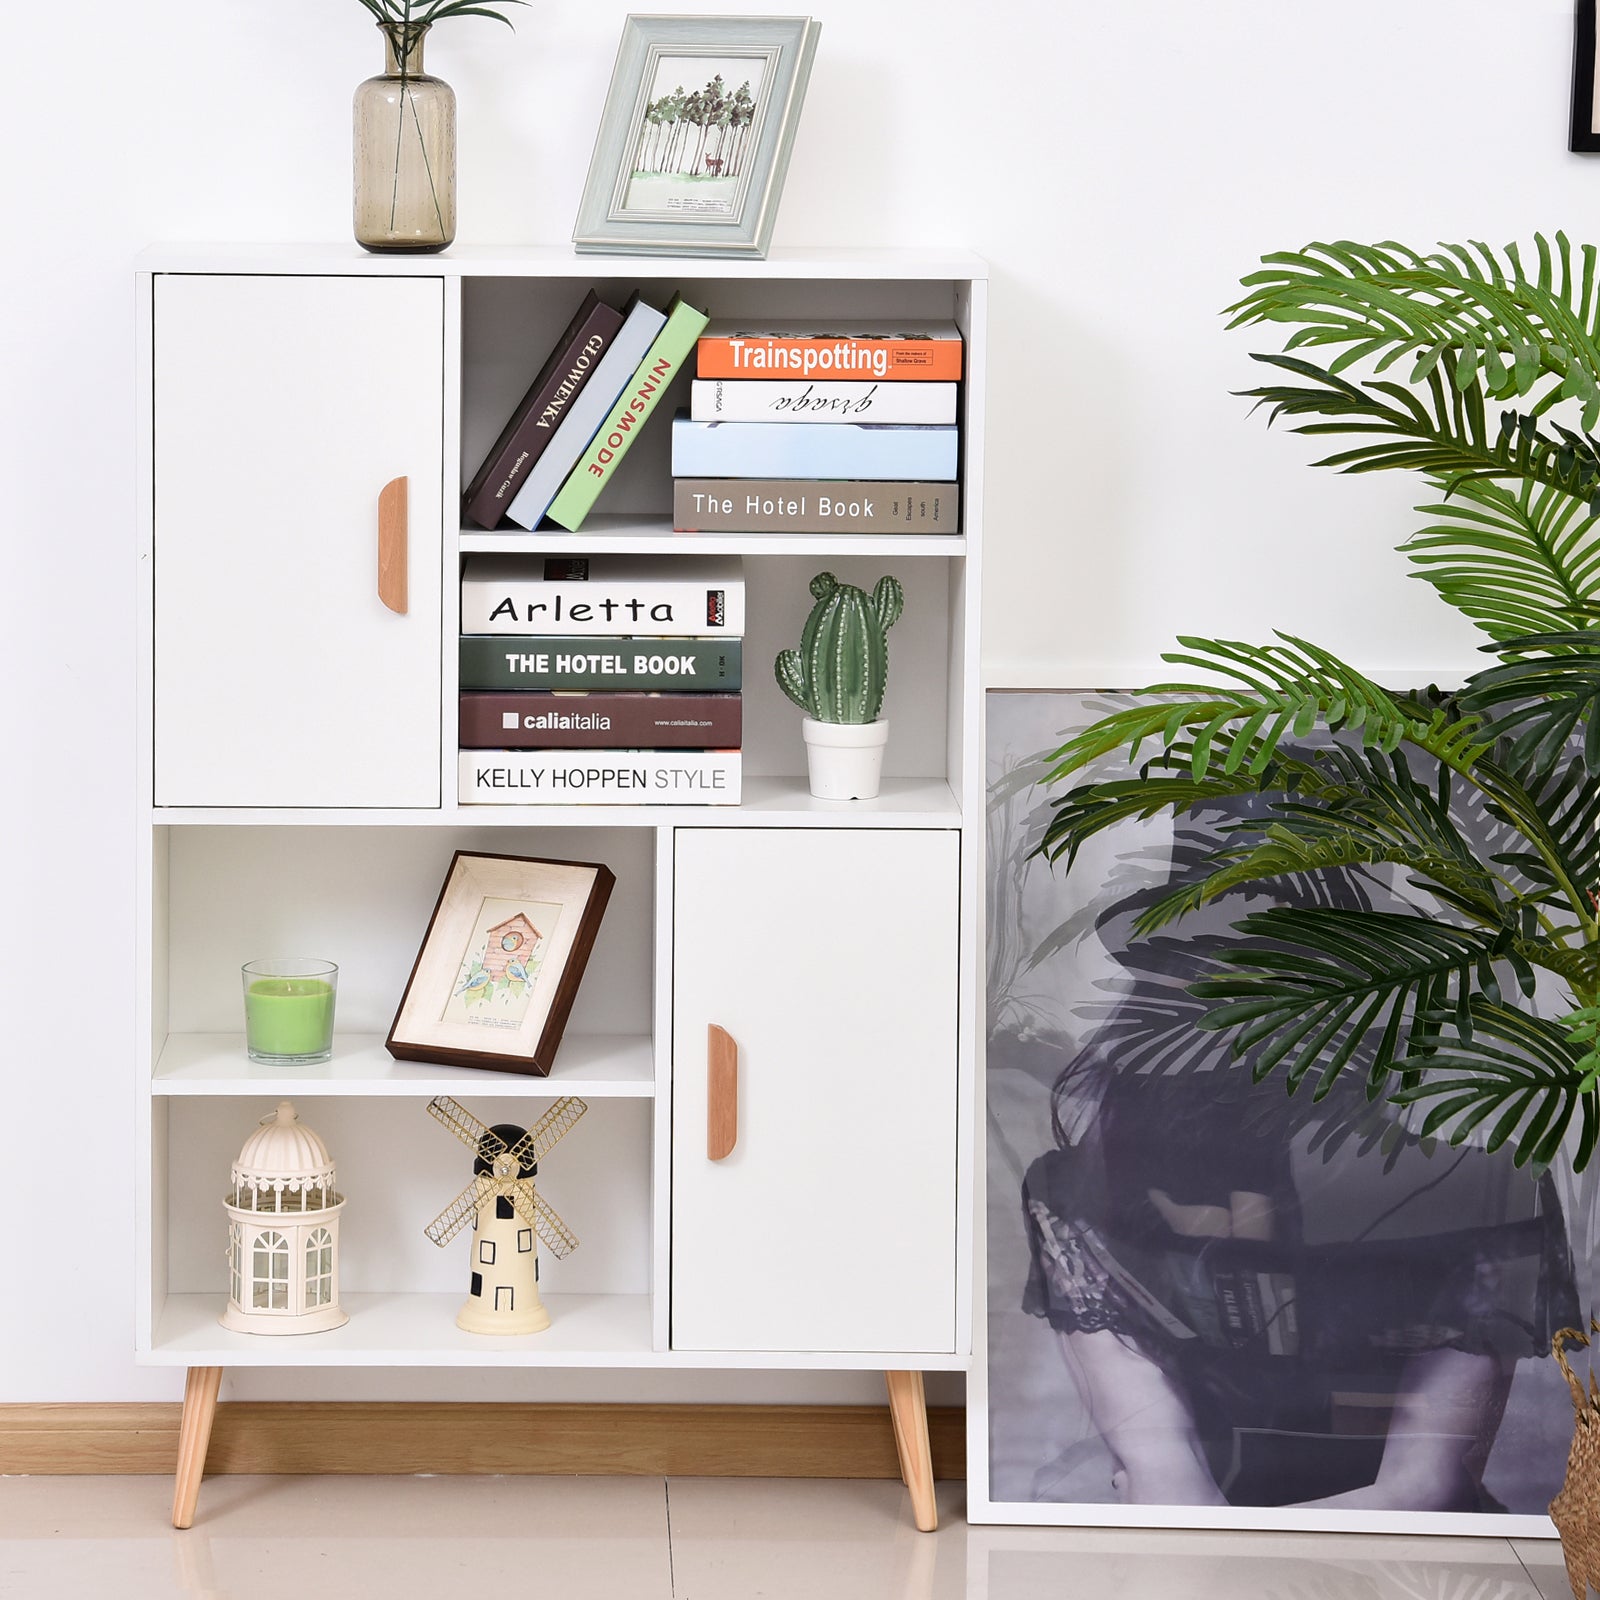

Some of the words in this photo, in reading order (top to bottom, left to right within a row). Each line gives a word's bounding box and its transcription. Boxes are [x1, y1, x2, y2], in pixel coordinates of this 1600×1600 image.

[588, 358, 671, 477] NINSMODE
[692, 494, 733, 515] The
[746, 495, 805, 516] Hotel
[819, 497, 874, 517] Book
[488, 595, 674, 623] Arletta
[505, 654, 549, 673] THE
[556, 654, 627, 674] HOTEL
[633, 655, 697, 675] BOOK
[523, 712, 611, 730] caliaitalia
[476, 768, 546, 788] KELLY
[552, 768, 647, 789] HOPPEN
[654, 769, 726, 789] STYLE
